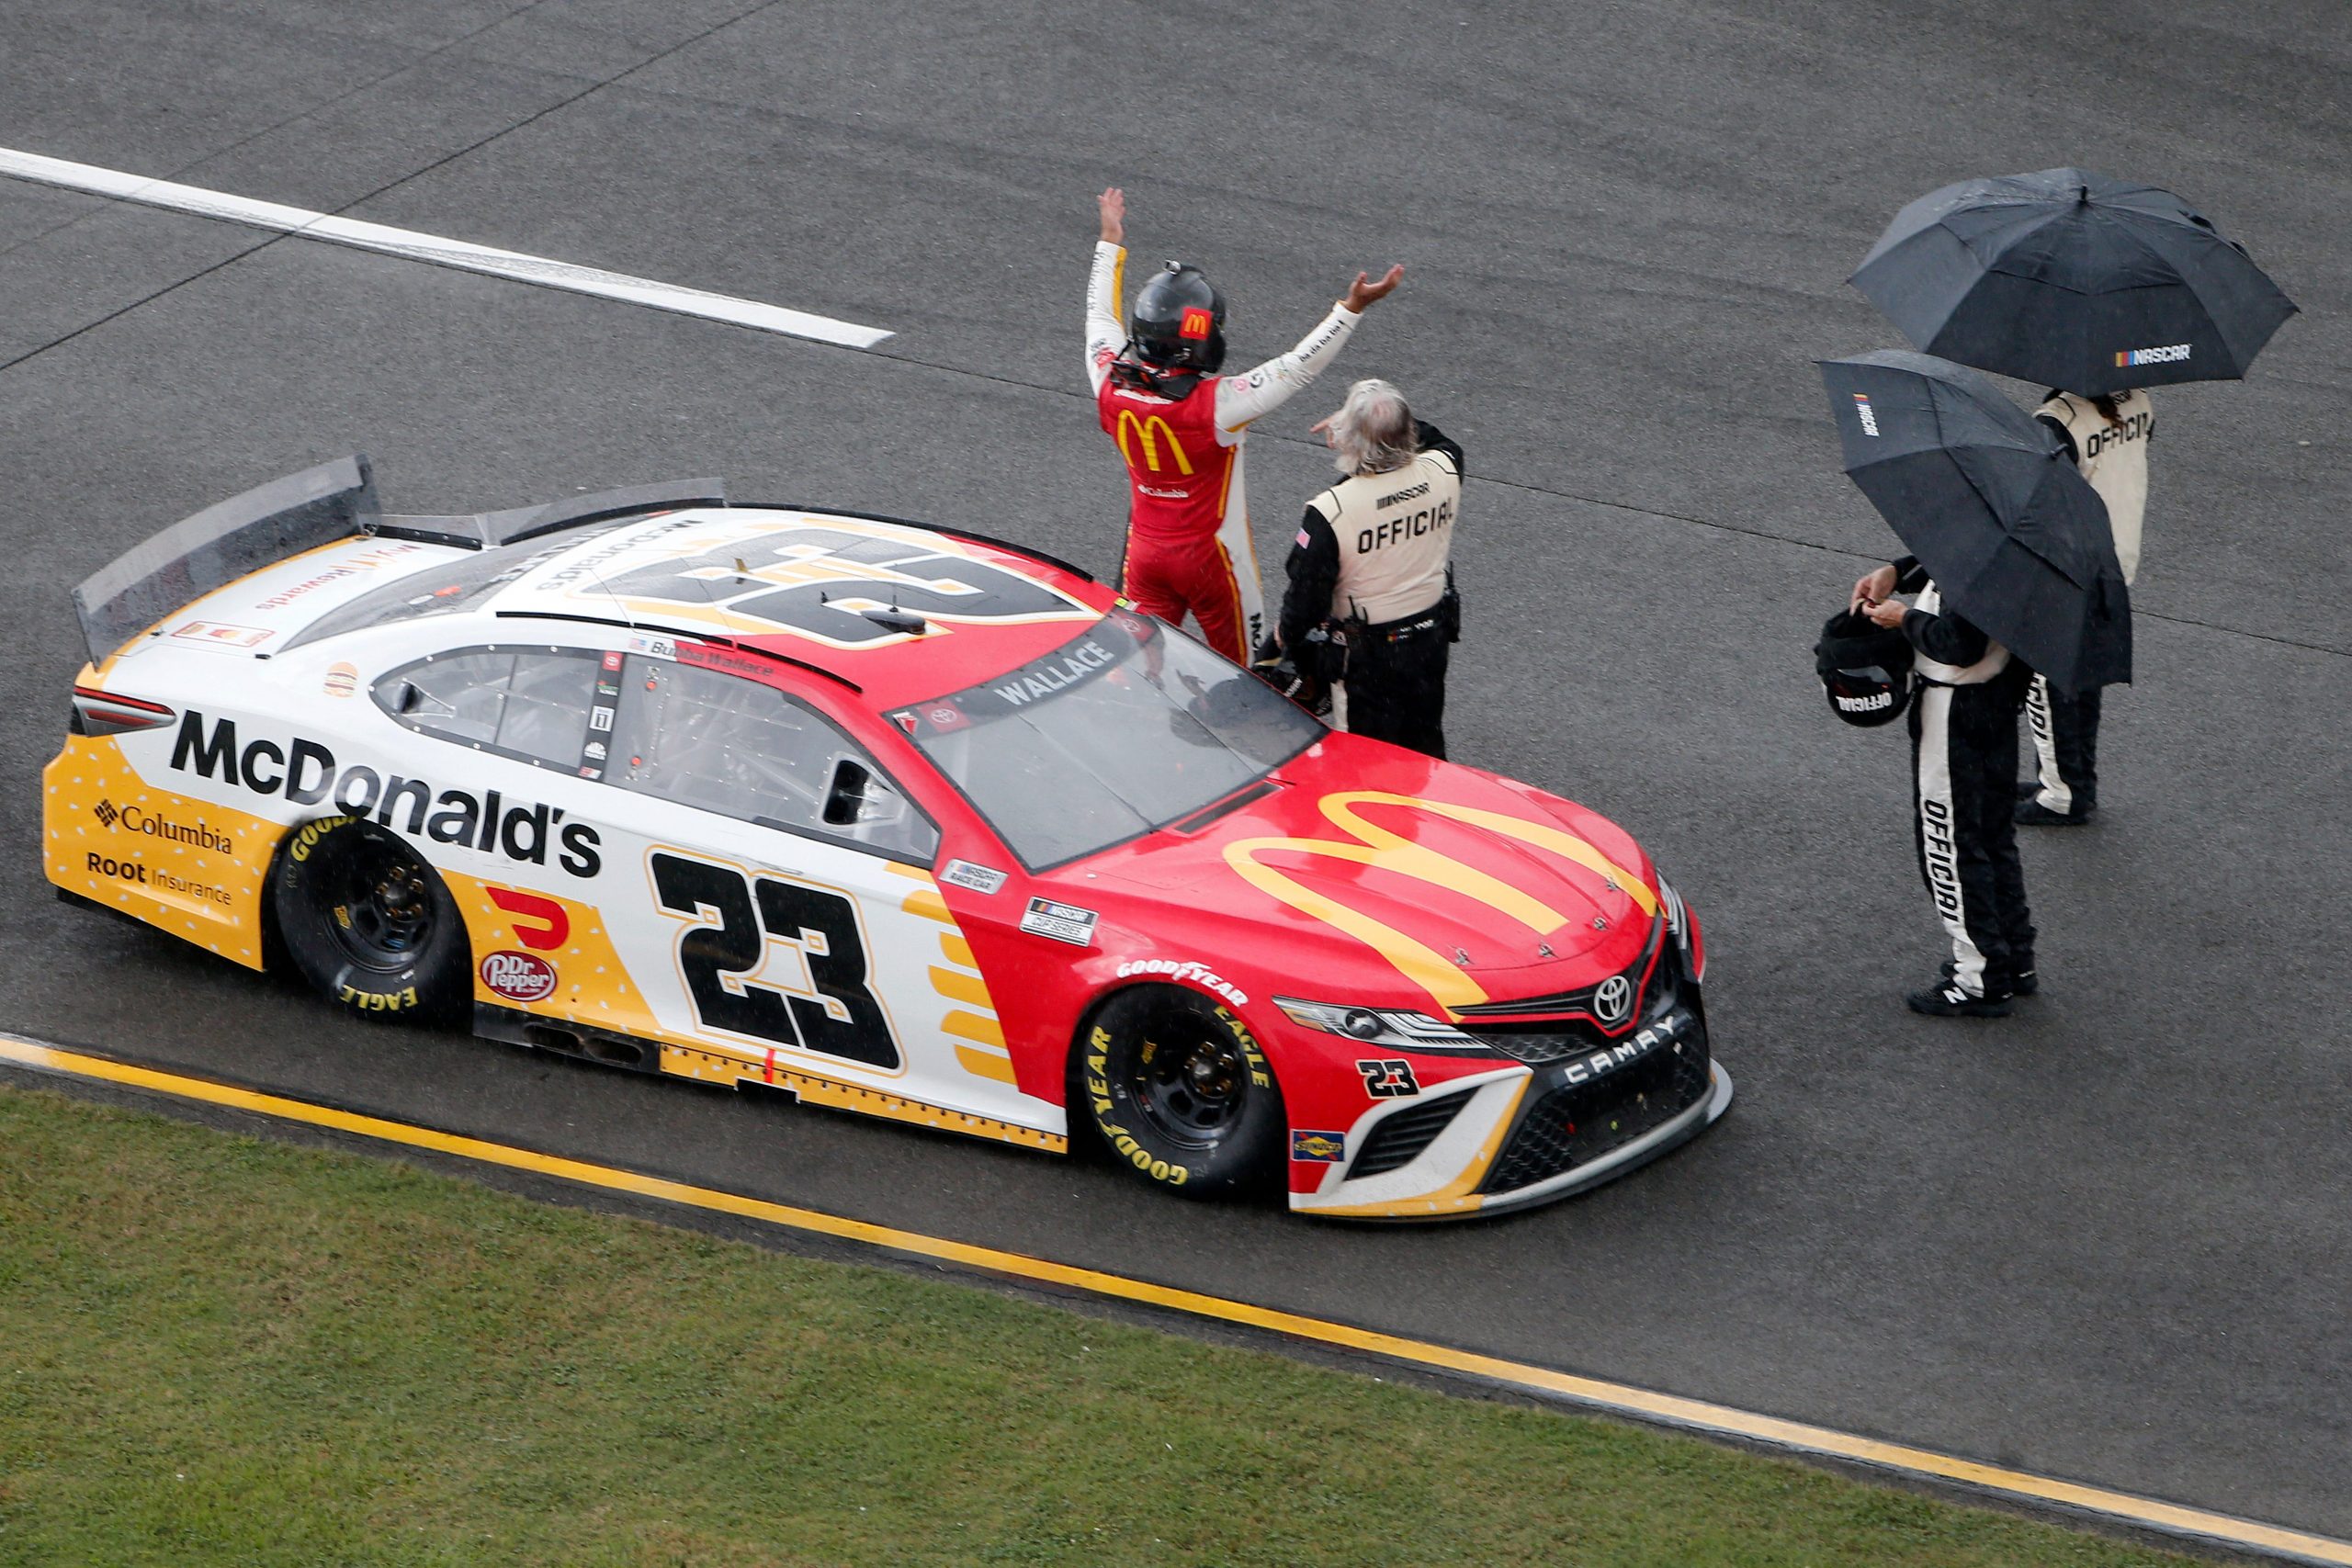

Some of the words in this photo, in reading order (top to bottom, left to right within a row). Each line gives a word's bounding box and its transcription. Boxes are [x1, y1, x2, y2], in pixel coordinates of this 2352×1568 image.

[2132, 344, 2191, 366] NASCAR
[1855, 403, 1880, 436] NASCAR
[1388, 482, 1430, 505] NASCAR
[650, 641, 704, 662] Bubba
[707, 652, 774, 677] Wallace
[992, 641, 1115, 706] WALLACE
[1836, 691, 1893, 713] OFFICIAL
[169, 710, 603, 879] McDonald's
[120, 806, 232, 855] Columbia
[87, 852, 147, 884] Root
[151, 868, 232, 906] Insurance
[481, 953, 550, 993] Pepper
[508, 954, 536, 975] Dr
[648, 850, 901, 1072] 23
[1115, 958, 1250, 1007] GOODYEAR
[338, 986, 419, 1011] EAGLE
[1213, 1005, 1271, 1089] EAGLE
[1563, 1014, 1675, 1085] CAMRY
[1356, 1059, 1420, 1098] 23
[1086, 1024, 1190, 1186] GOODYEAR
